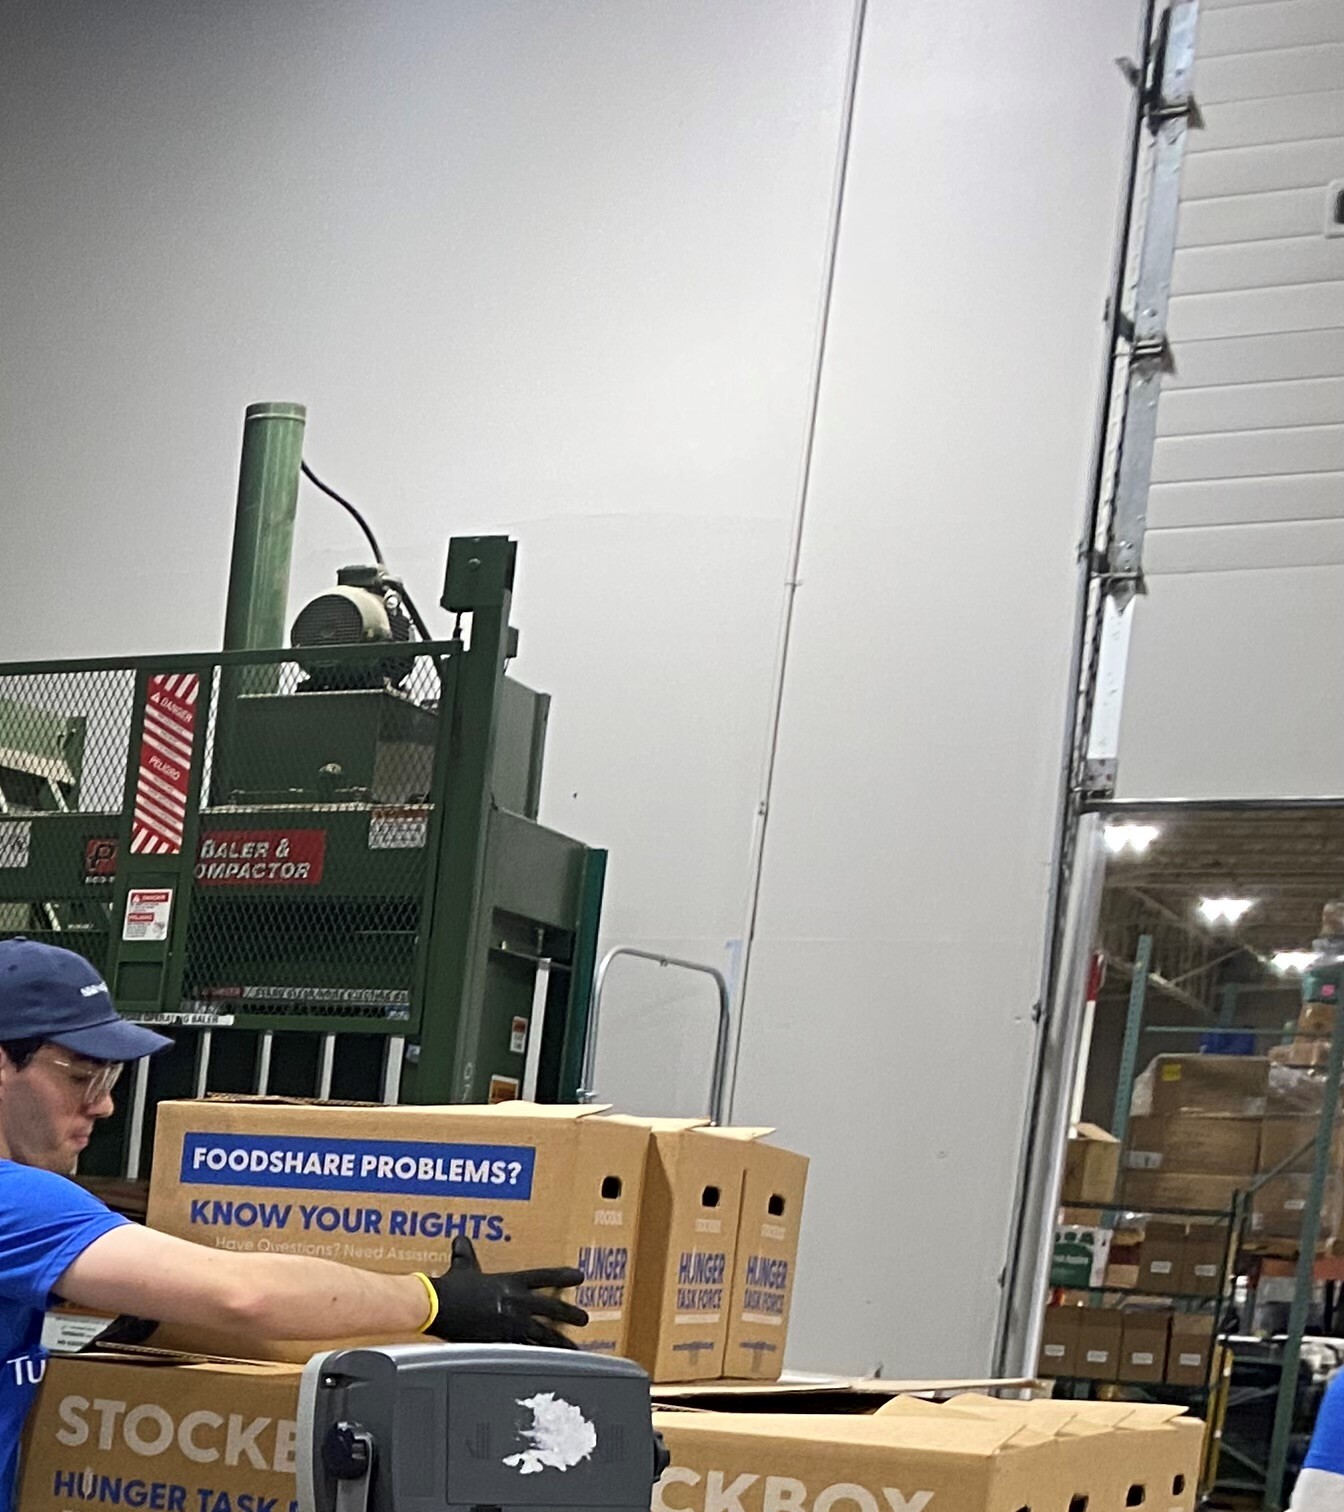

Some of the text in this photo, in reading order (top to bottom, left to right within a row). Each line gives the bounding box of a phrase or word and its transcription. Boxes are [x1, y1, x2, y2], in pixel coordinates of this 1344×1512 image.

[160, 697, 193, 724] DANGER
[149, 755, 180, 781] PELIGRO
[200, 839, 271, 860] BALER
[194, 862, 311, 880] OMPACTOR
[193, 1147, 522, 1185] FOODSHARE PROBLEMS?
[191, 1200, 512, 1242] KNOW YOUR RIGHTS.
[216, 1237, 383, 1260] Have Questions? Need
[579, 1246, 628, 1281] HUNGER
[678, 1252, 726, 1285] HUNGER
[746, 1255, 788, 1290] HUNGER
[599, 1284, 625, 1308] FORCE
[698, 1288, 723, 1310] FORCE
[54, 1395, 297, 1473] STOCKB
[54, 1468, 186, 1512] HUNGER
